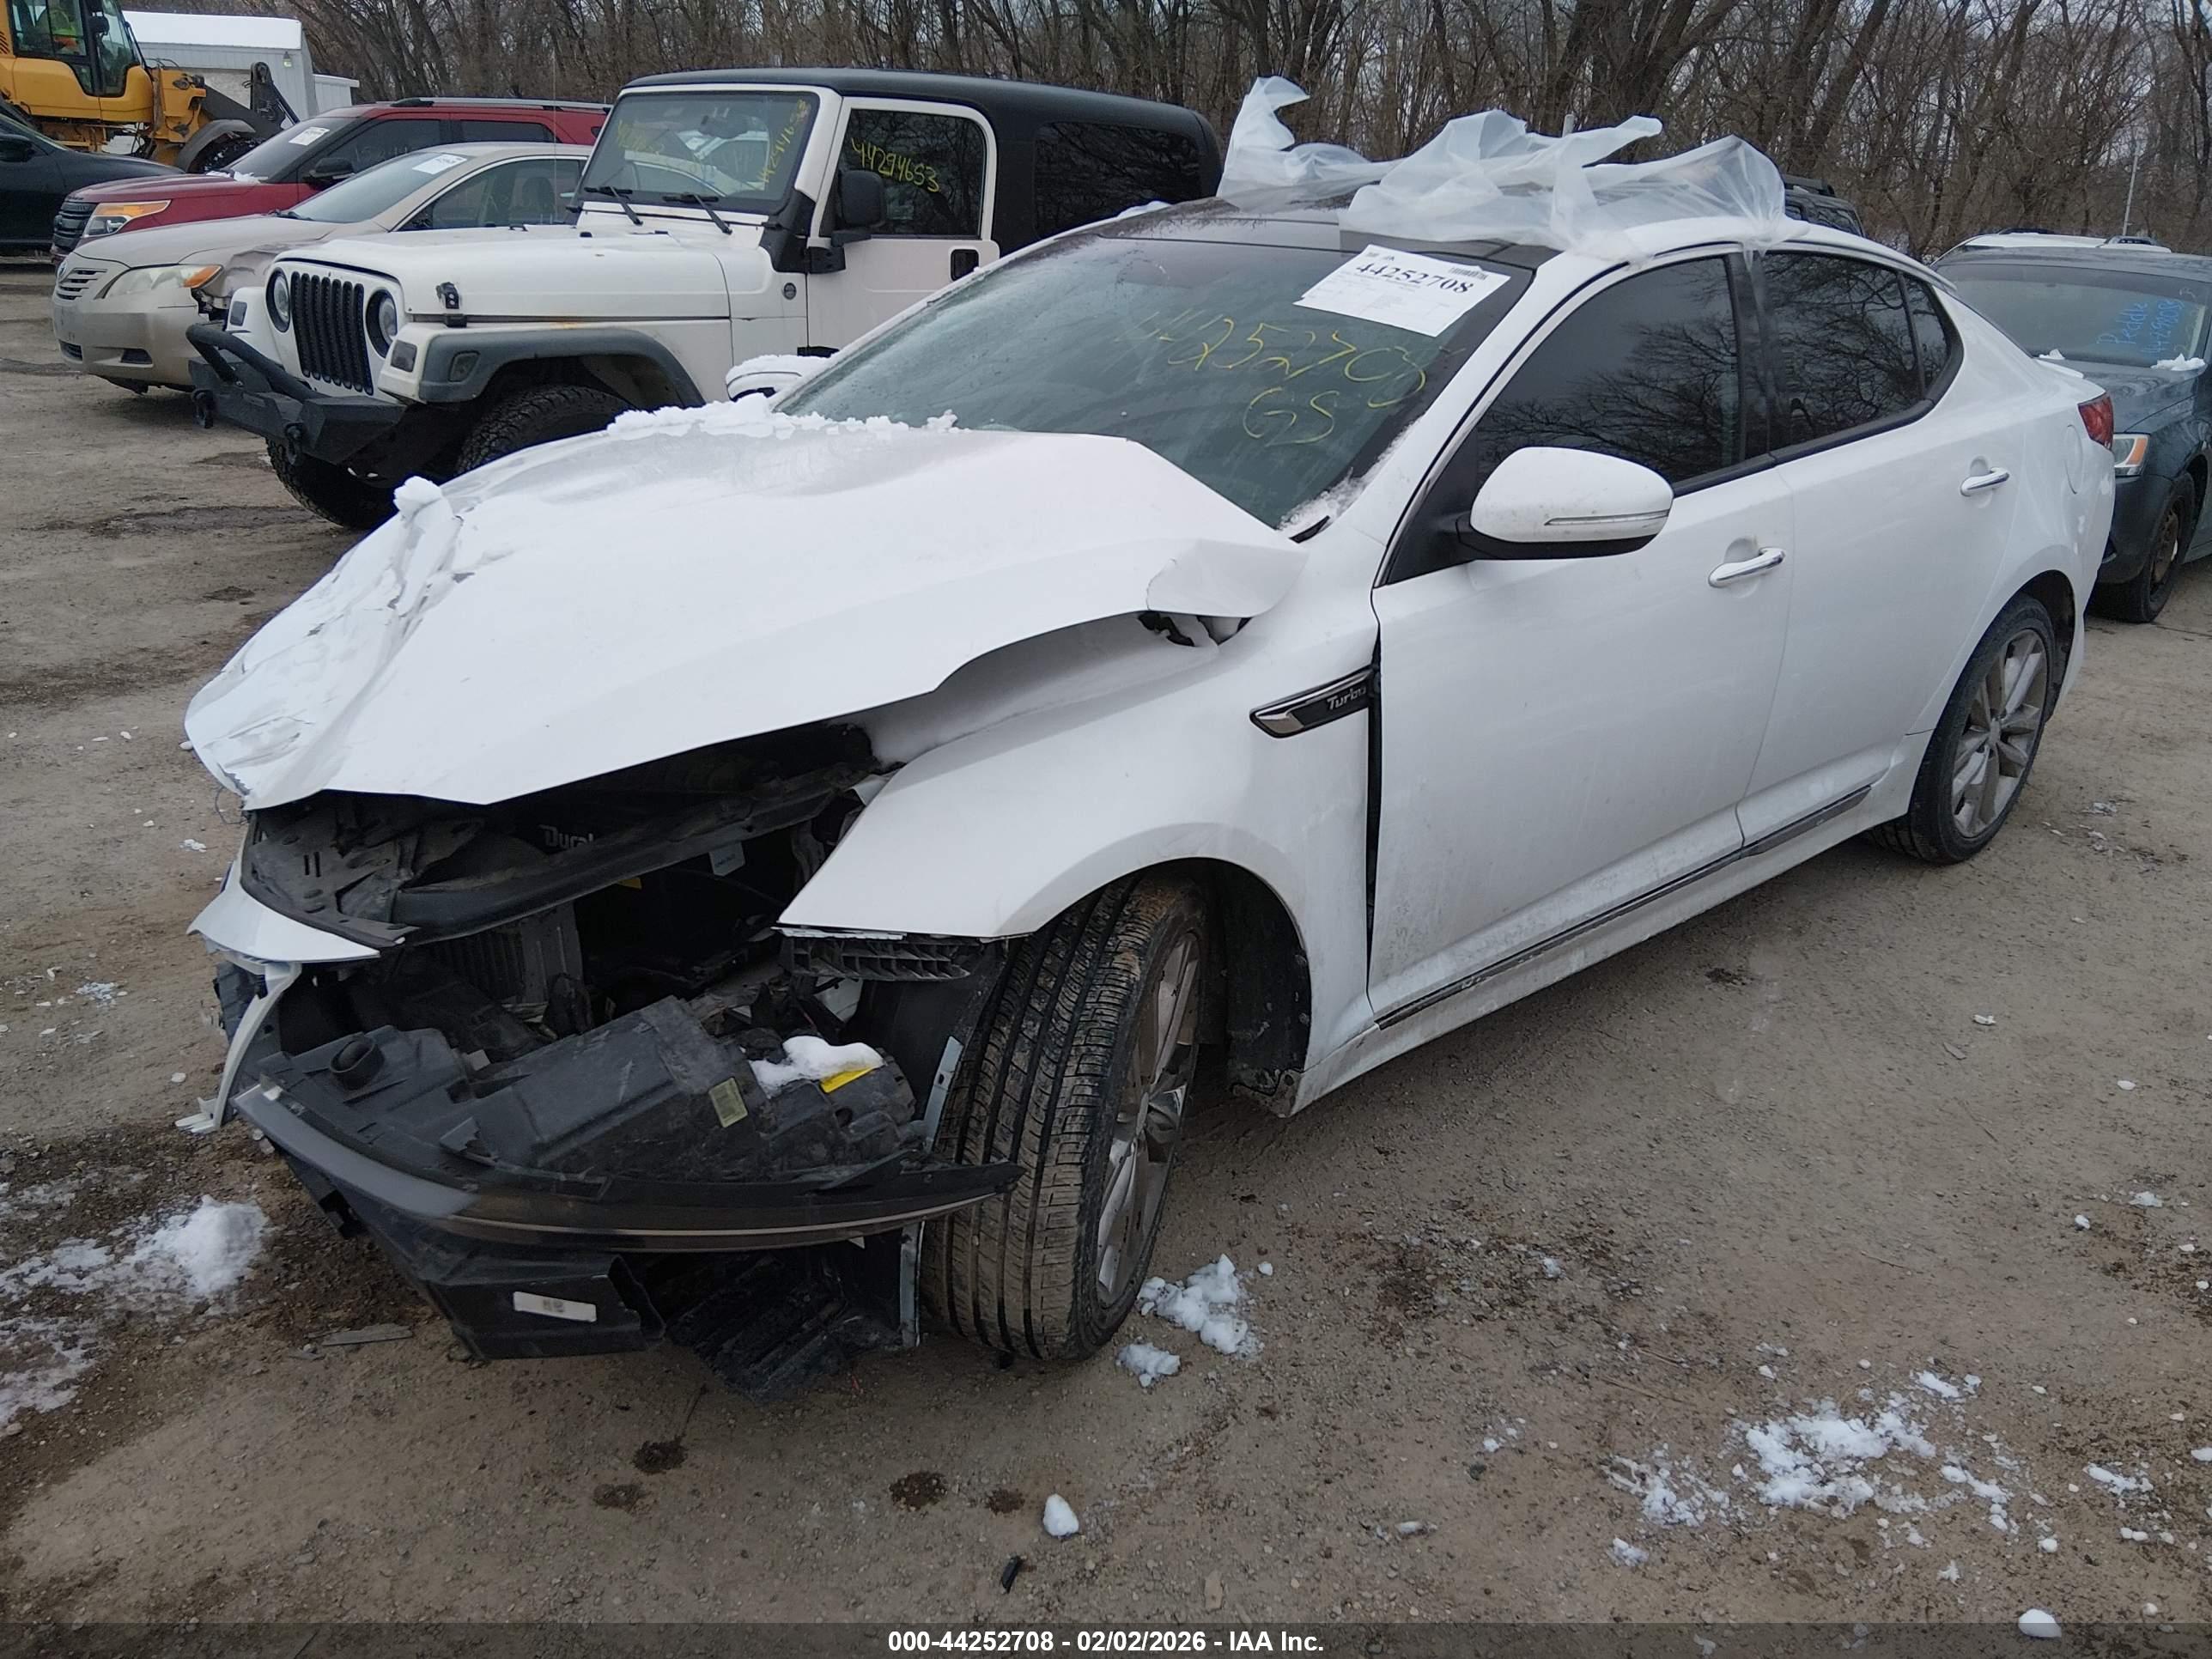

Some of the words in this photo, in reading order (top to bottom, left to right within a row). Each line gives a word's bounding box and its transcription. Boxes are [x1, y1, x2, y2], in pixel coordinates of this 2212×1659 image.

[851, 137, 940, 192] 44294653
[1356, 262, 1474, 294] 44252708
[1327, 686, 1367, 711] Turbo
